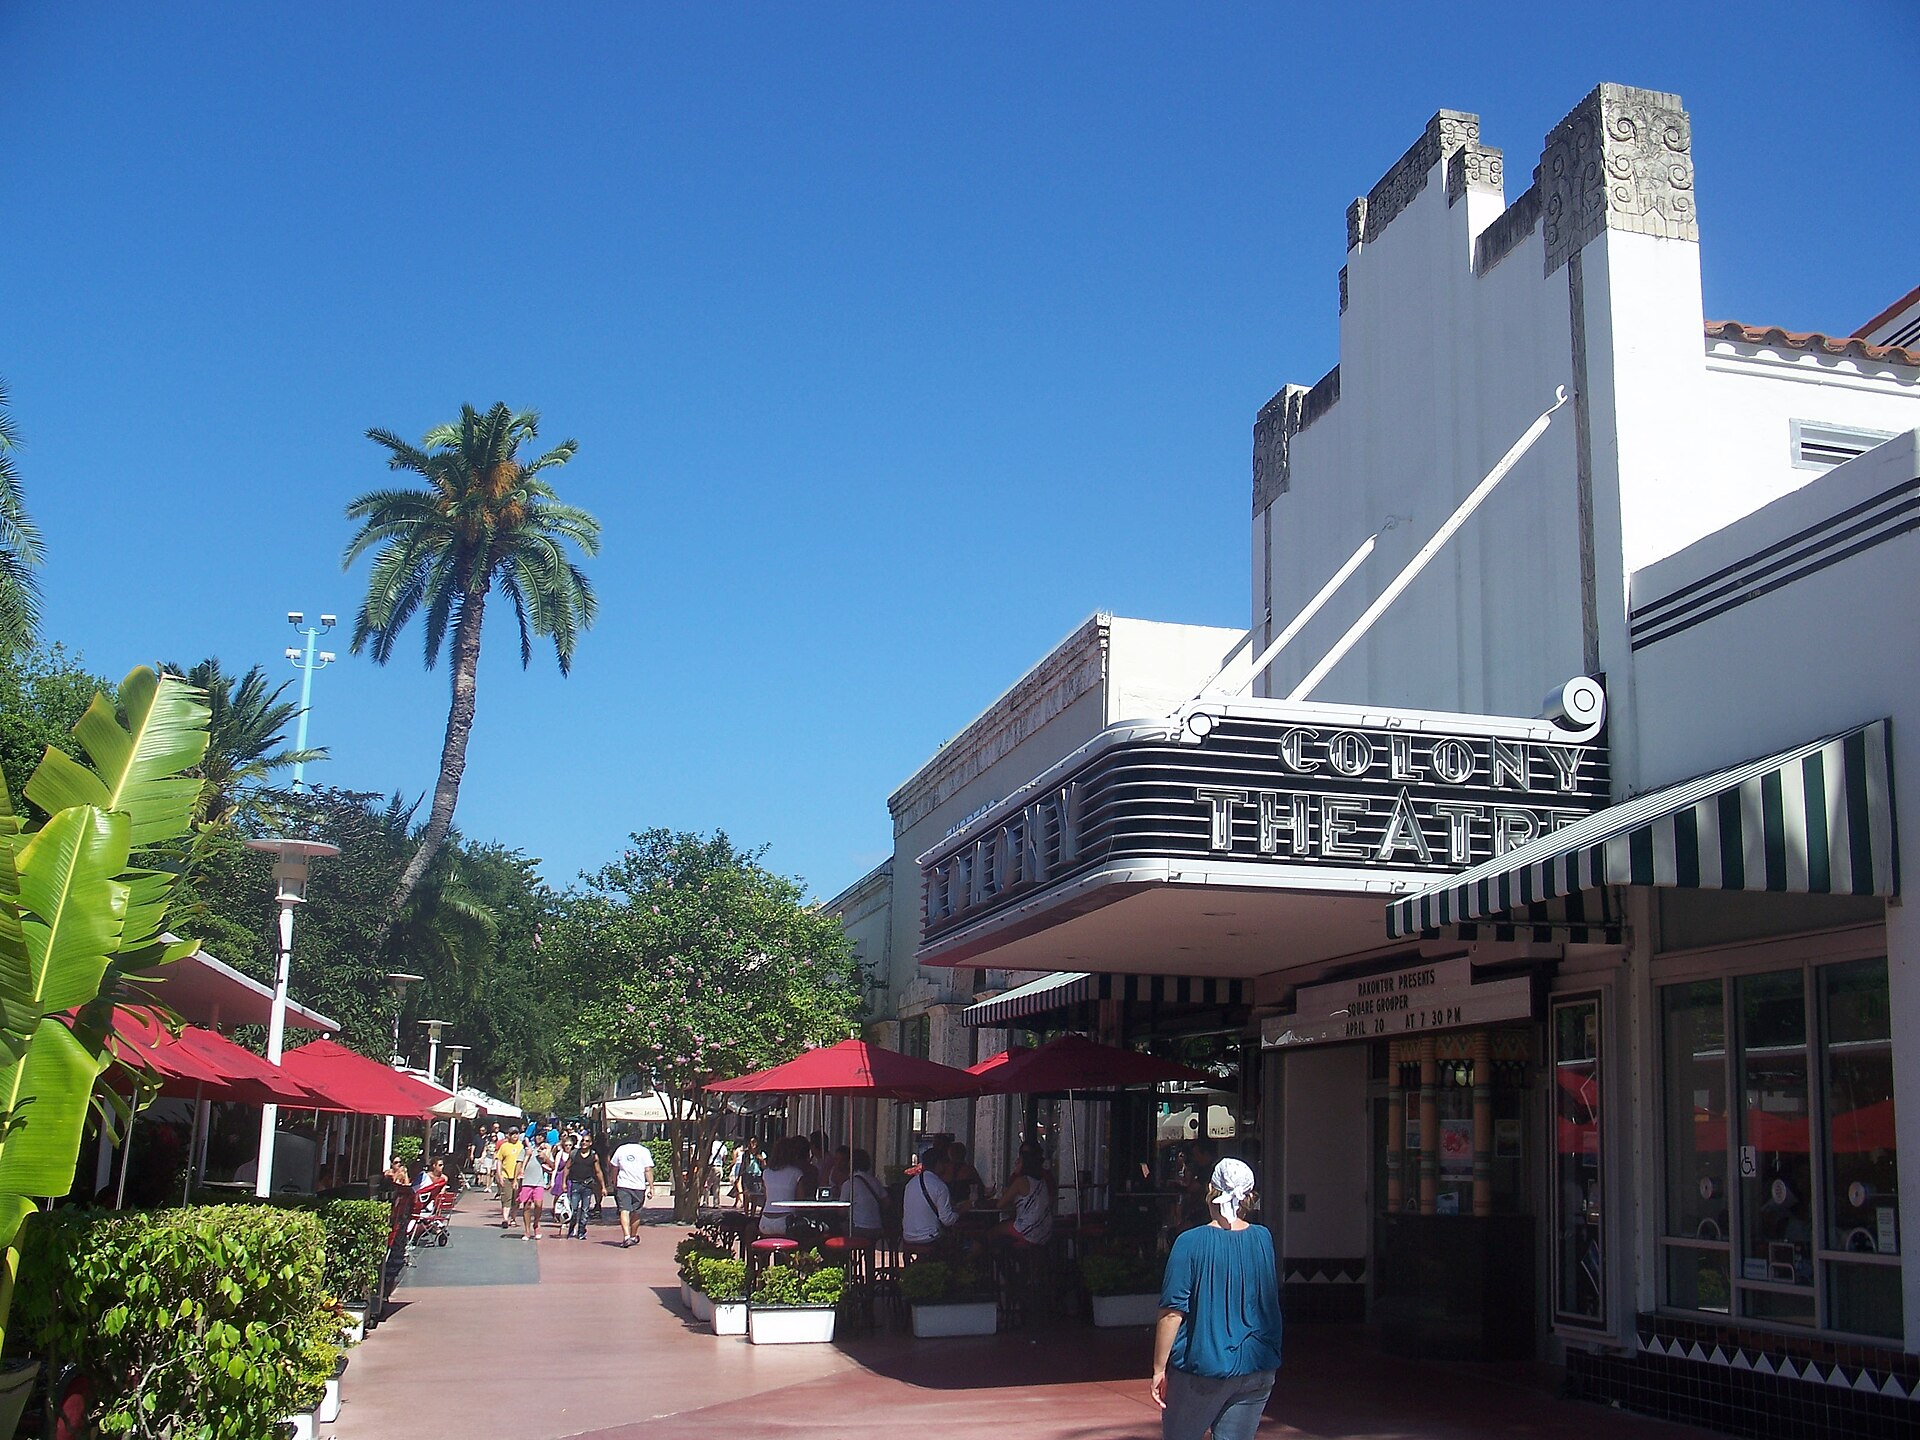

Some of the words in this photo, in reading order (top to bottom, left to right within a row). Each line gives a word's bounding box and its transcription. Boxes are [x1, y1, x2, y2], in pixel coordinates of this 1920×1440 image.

[1281, 726, 1585, 792] COLONY
[1358, 977, 1394, 997] RAKONTUR
[1398, 969, 1435, 989] PRESENTS
[1347, 999, 1374, 1018] SQUARE
[1376, 994, 1408, 1013] GROUPER
[1345, 1020, 1366, 1037] APRIL
[1374, 1018, 1385, 1033] 20
[1405, 1013, 1415, 1029] AT
[1420, 1011, 1425, 1027] 7
[1431, 1009, 1443, 1026] 30
